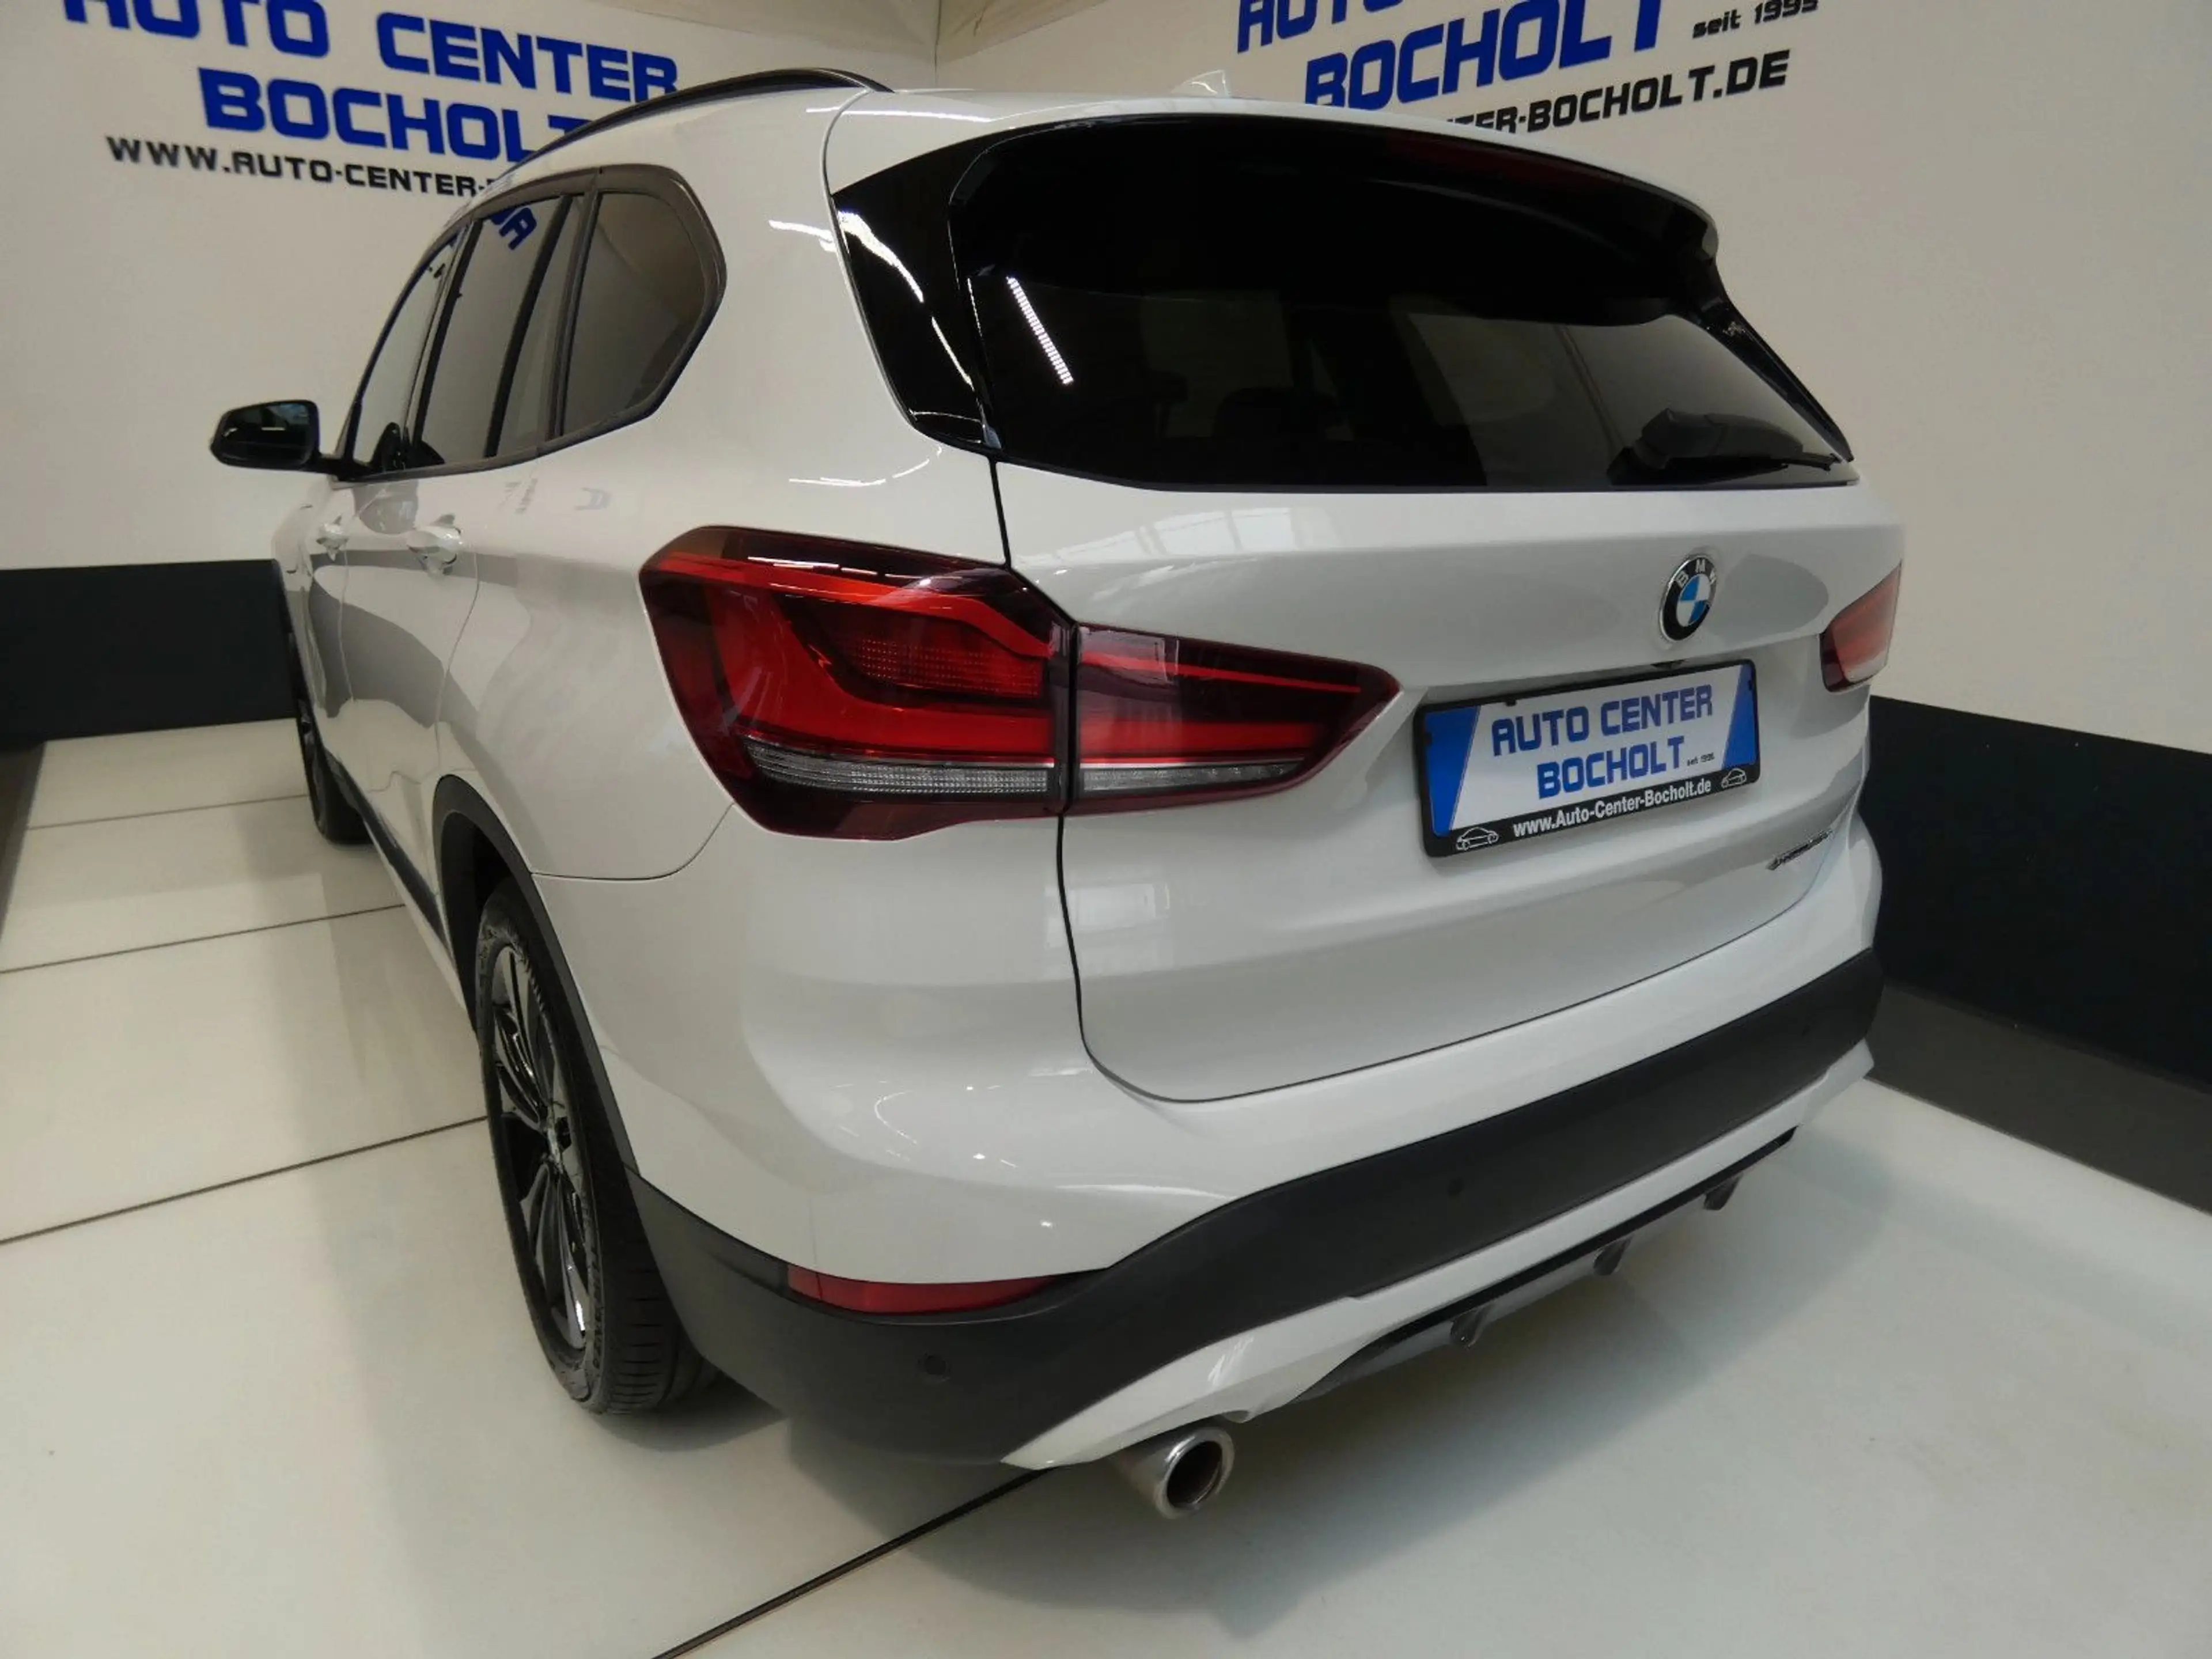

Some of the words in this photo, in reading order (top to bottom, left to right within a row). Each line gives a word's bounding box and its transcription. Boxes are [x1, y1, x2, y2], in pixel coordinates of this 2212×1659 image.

[1237, 0, 1402, 54] AU
[1692, 9, 1741, 39] seit
[376, 12, 679, 103] CENTER
[1446, 50, 1790, 134] ER-BOCHOLT.DE
[1491, 706, 1589, 757] AUTO
[1601, 684, 1713, 737] CENTER
[1537, 736, 1684, 800] BOCHOLT
[1513, 779, 1711, 836] www.Auto-Center-Bocholt.de
